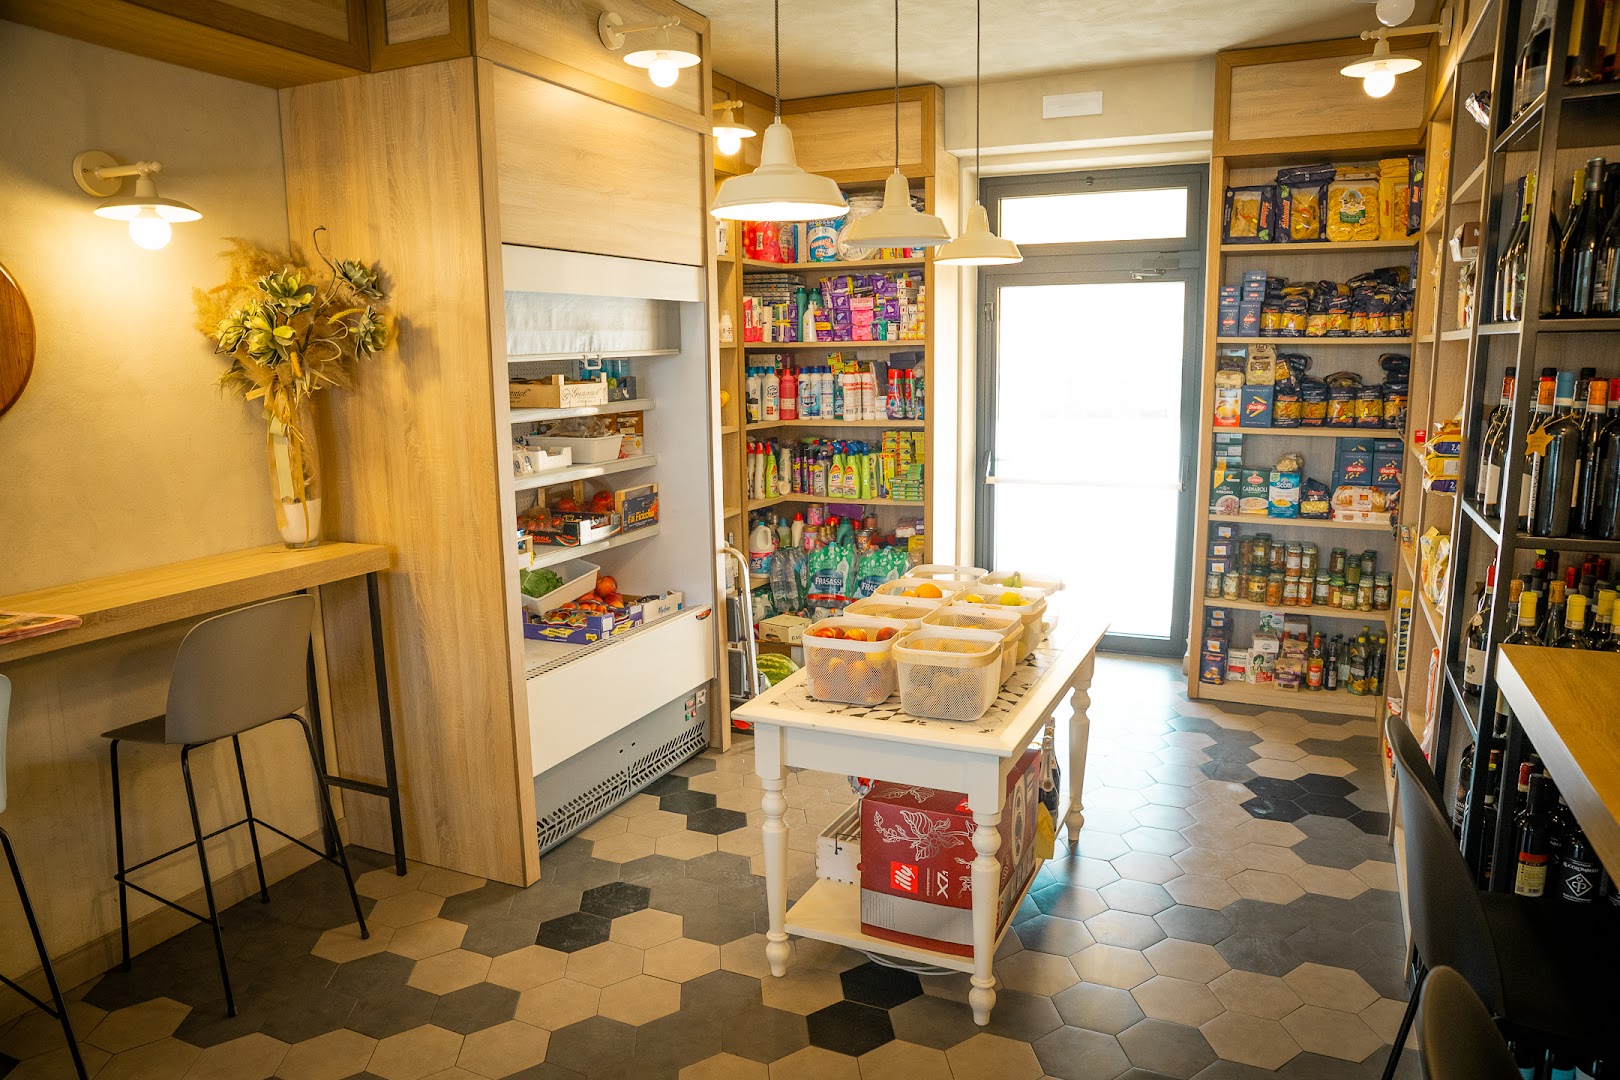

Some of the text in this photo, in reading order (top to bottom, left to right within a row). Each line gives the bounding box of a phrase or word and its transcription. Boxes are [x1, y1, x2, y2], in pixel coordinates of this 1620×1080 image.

[815, 577, 842, 586] FRASASSI
[861, 582, 877, 591] FRAS
[895, 865, 915, 890] illy
